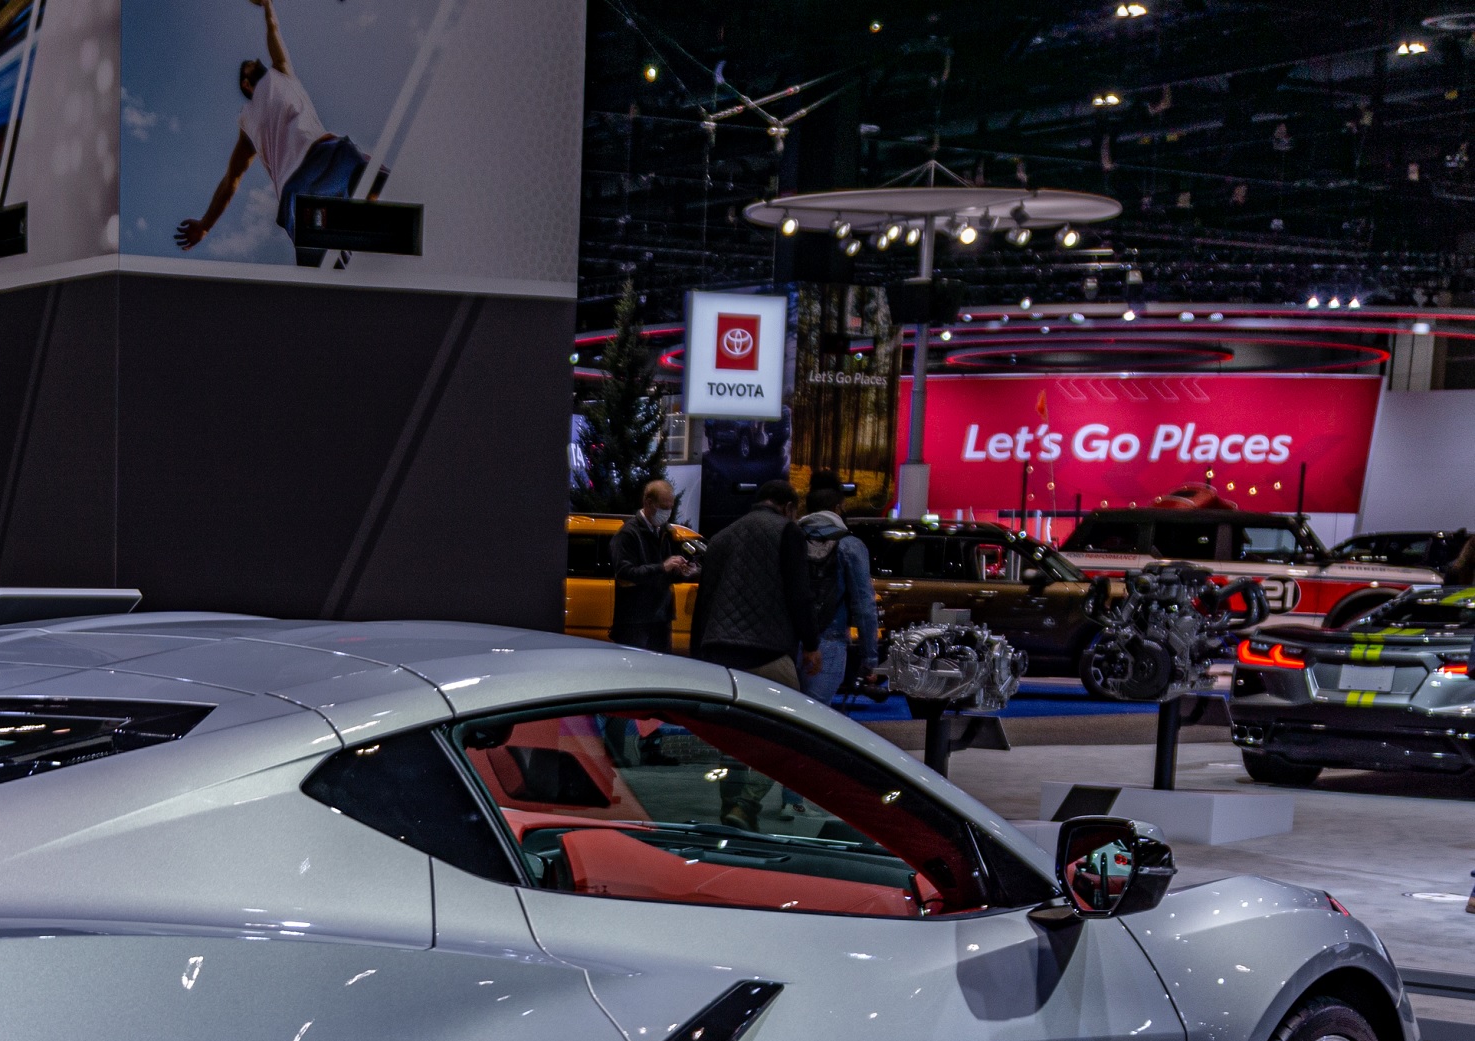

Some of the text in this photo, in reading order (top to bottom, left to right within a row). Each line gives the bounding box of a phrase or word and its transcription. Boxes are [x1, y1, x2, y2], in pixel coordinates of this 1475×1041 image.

[809, 369, 888, 385] Let's Go Places
[707, 382, 765, 398] TOYOTA
[963, 422, 1292, 463] Let's Go Places
[1260, 579, 1295, 609] 21
